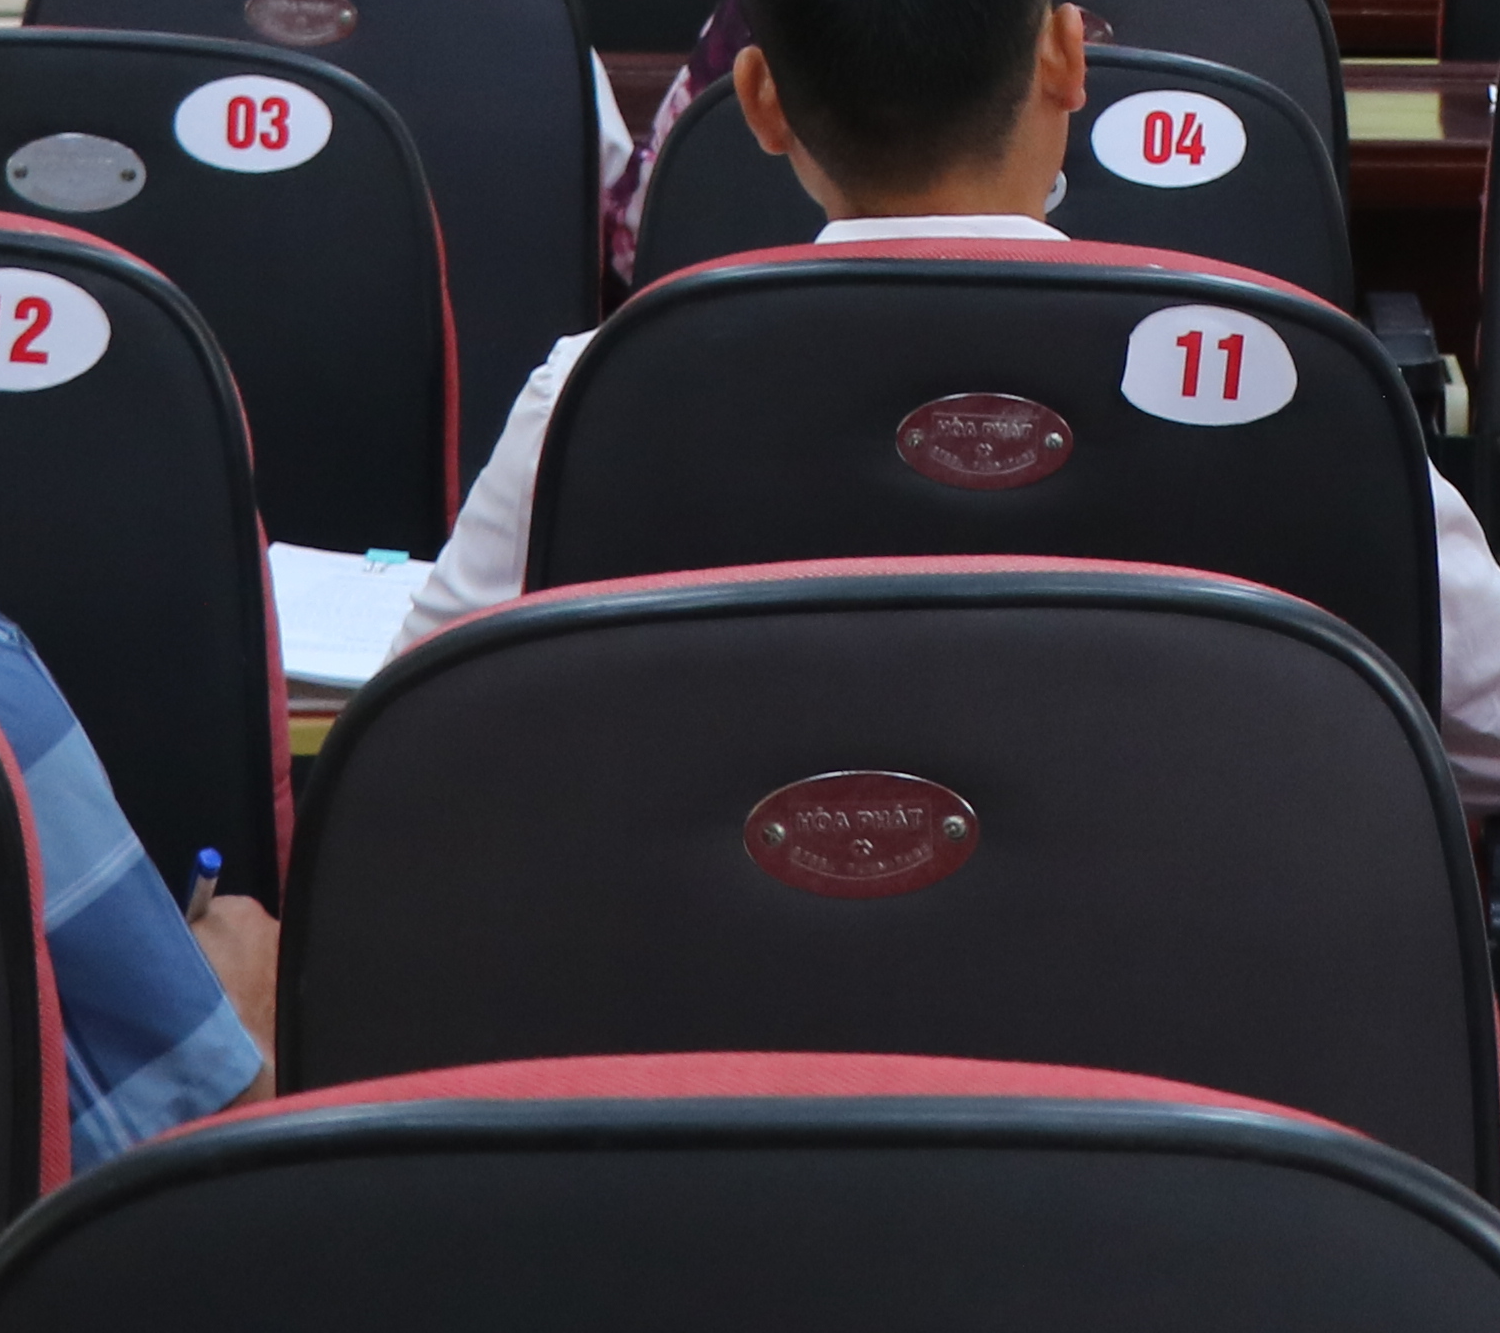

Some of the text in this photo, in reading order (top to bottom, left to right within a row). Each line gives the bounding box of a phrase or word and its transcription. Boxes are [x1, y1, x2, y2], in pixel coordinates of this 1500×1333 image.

[226, 95, 290, 152] 03
[1142, 111, 1206, 166] 04
[1175, 330, 1244, 401] 11
[794, 805, 924, 831] HÒA PHÁT
